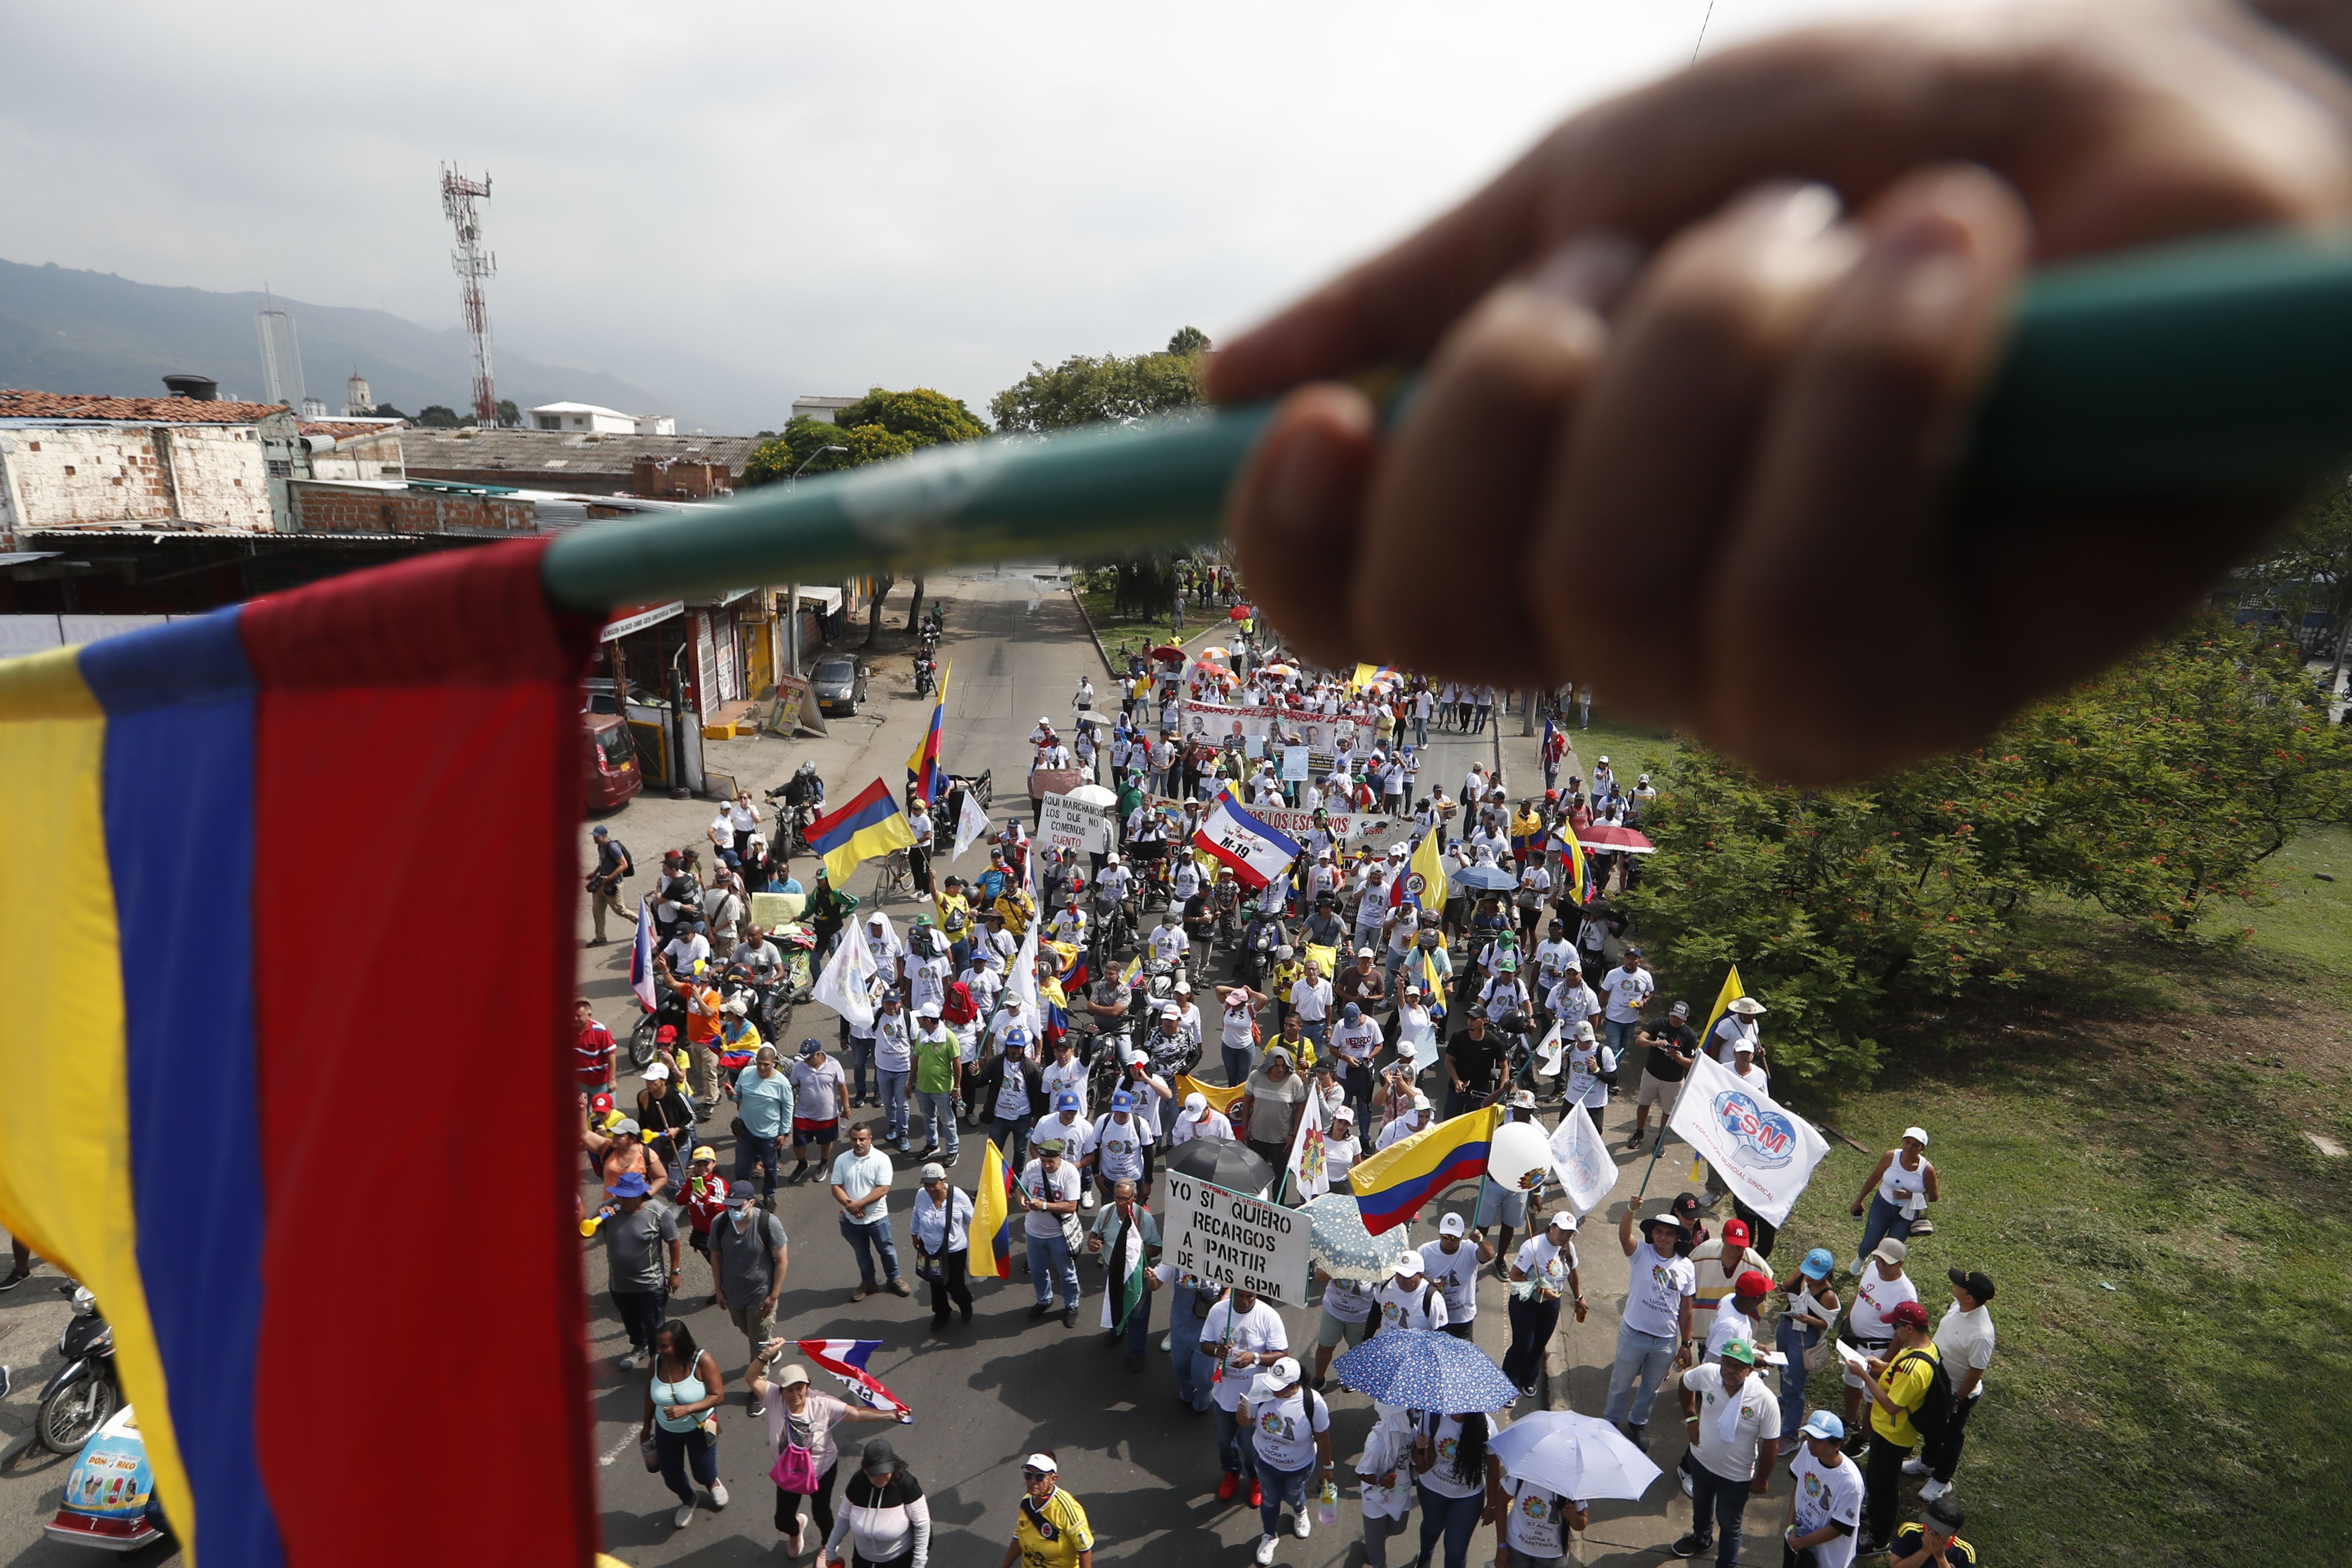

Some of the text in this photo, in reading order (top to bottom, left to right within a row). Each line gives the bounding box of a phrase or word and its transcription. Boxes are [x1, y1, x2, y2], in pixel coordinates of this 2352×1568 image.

[1185, 702, 1235, 715] ASESORES
[1235, 707, 1258, 717] DEL
[1042, 795, 1104, 817] AQUI MARCHAMOS
[1046, 808, 1099, 828] LOS QUE NO
[1267, 811, 1288, 829] LOS
[1051, 821, 1086, 836] COMEMOS
[1363, 827, 1383, 835] FSM
[1052, 834, 1081, 847] CUENTO
[1220, 836, 1250, 859] M-19
[1722, 1101, 1787, 1154] FSM
[1721, 1156, 1746, 1180] MUNDIAL
[1746, 1177, 1774, 1202] SINDICAL
[1200, 1182, 1232, 1198] REFORMA
[1169, 1179, 1292, 1234] YO SI QUIERO
[1237, 1196, 1272, 1211] LABORAL
[1194, 1211, 1275, 1252] RECARGOS
[1183, 1231, 1266, 1274] A PARTIR
[1178, 1250, 1280, 1298] DE LAS 6PM
[1650, 1298, 1667, 1307] LUCHA
[1805, 1509, 1812, 1517] DE
[90, 1517, 97, 1530] 7
[1519, 1534, 1557, 1547] RESISTENCIA
